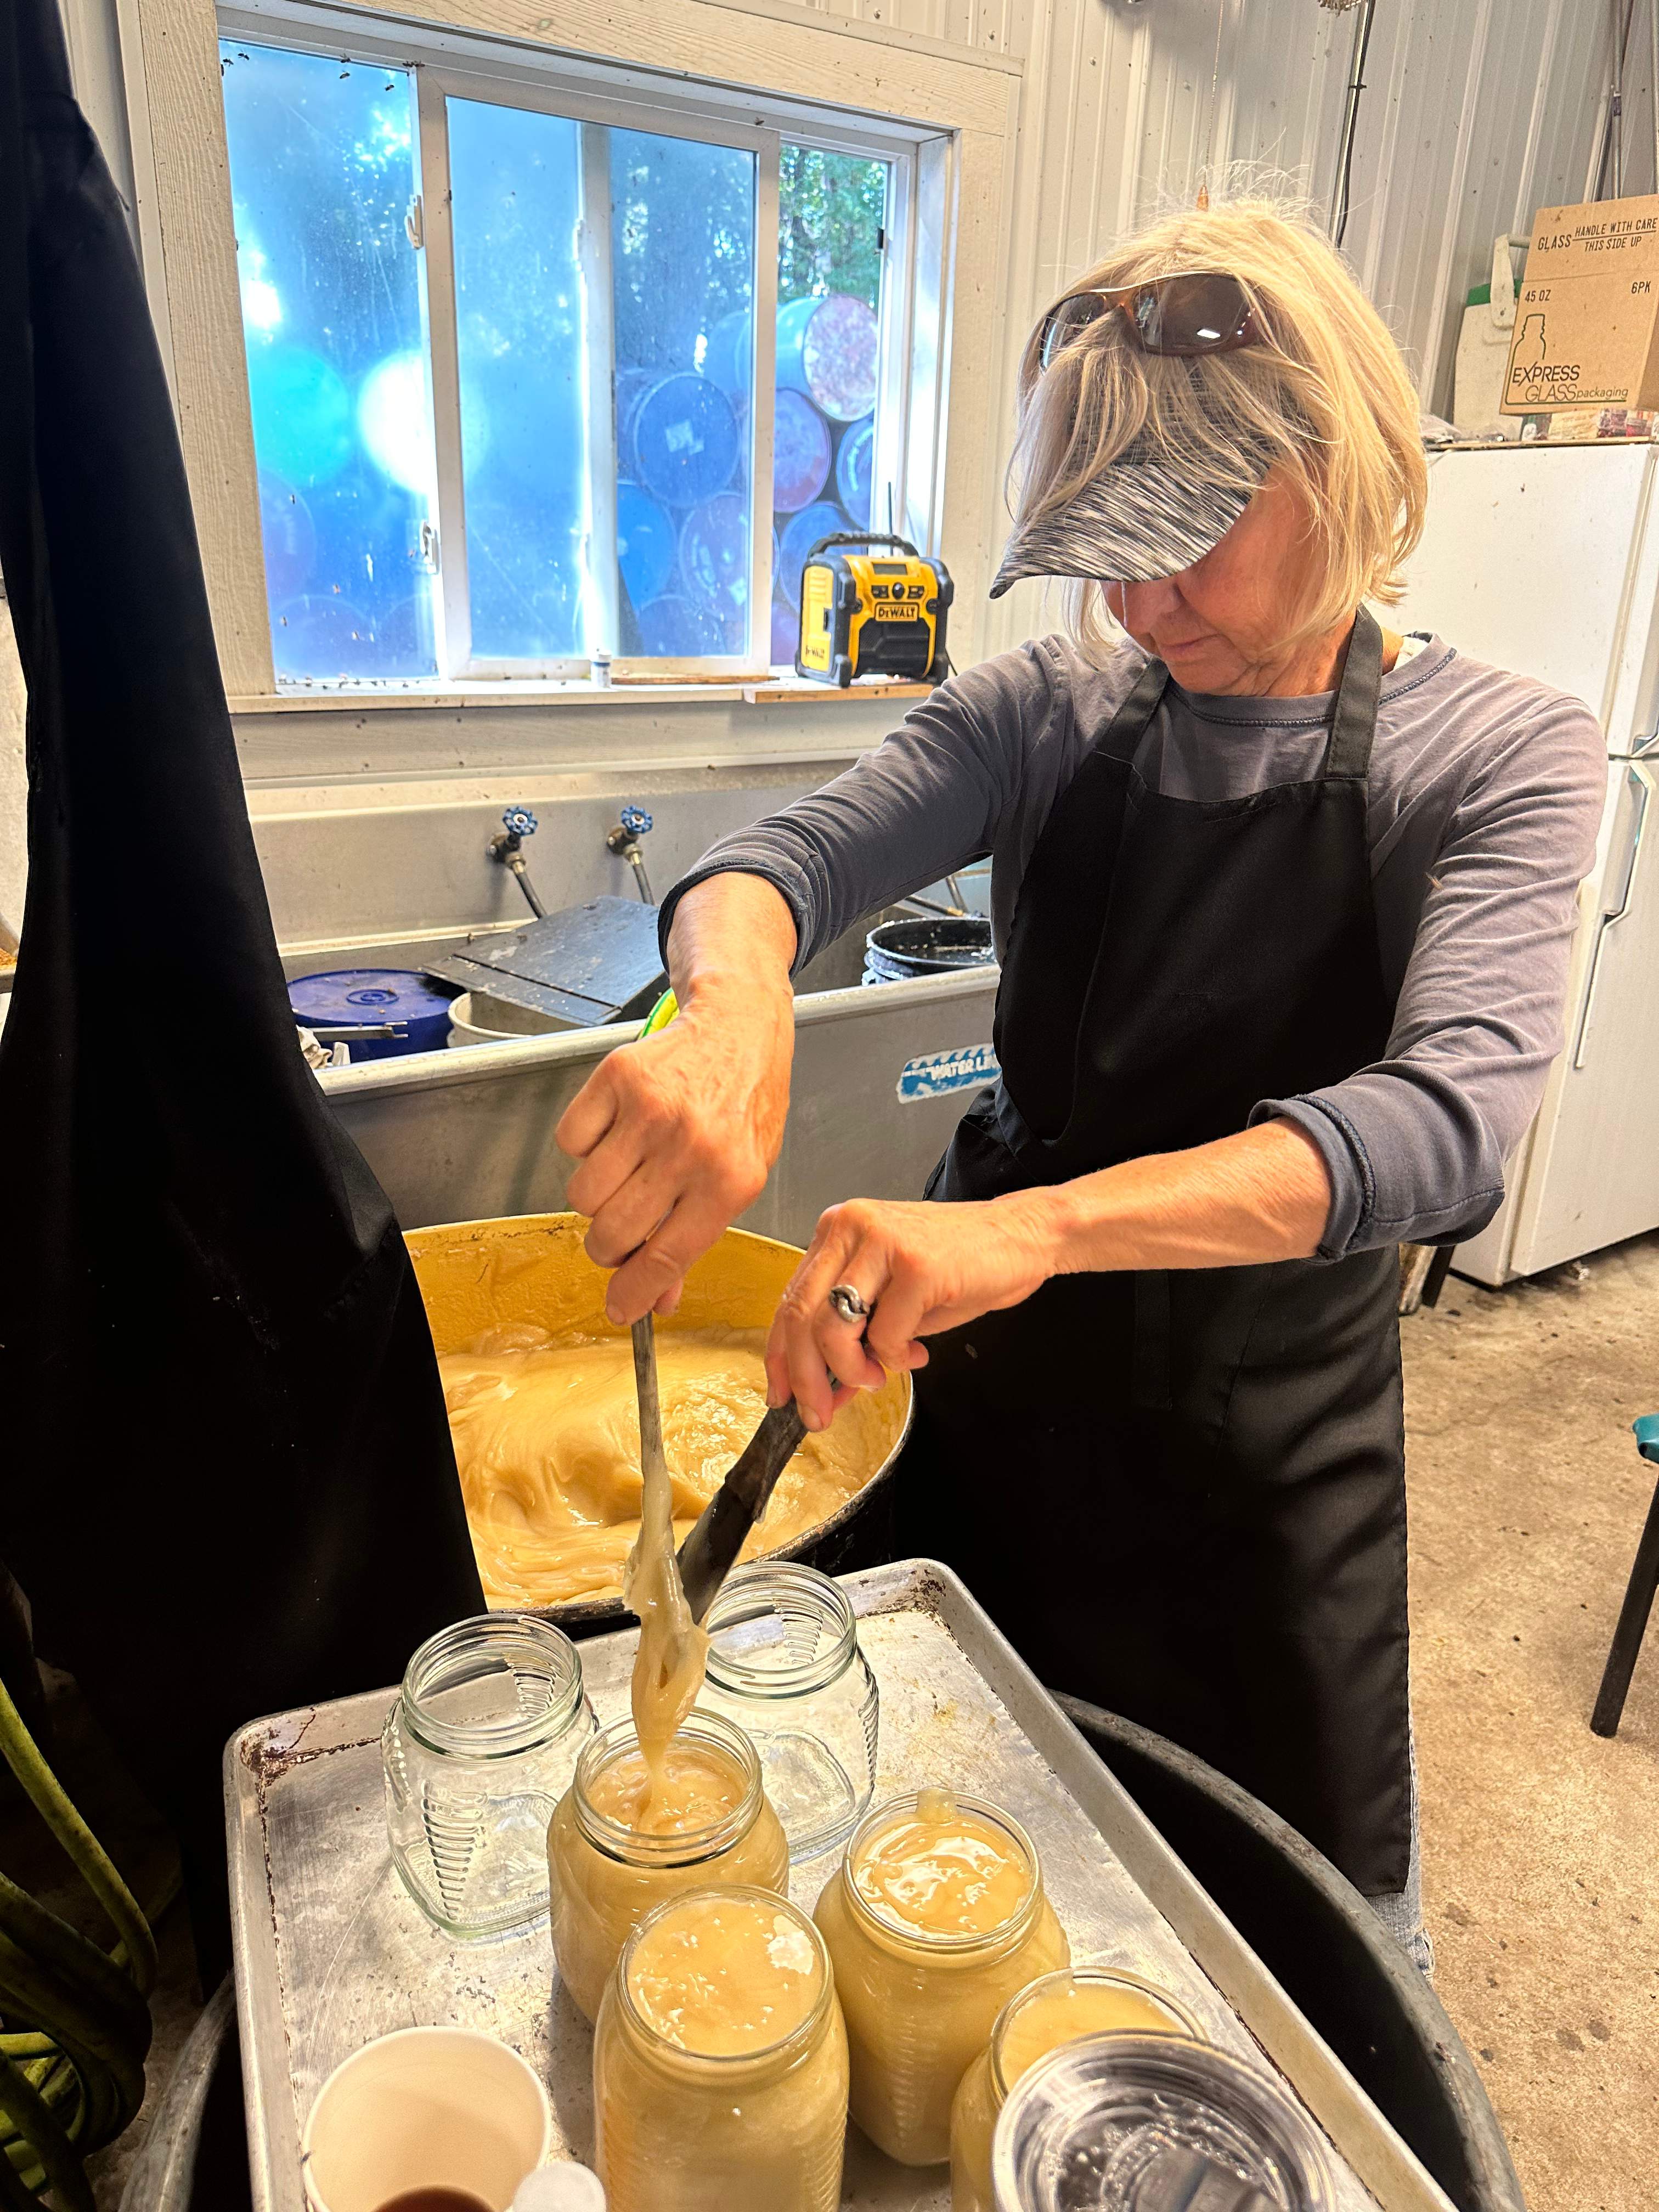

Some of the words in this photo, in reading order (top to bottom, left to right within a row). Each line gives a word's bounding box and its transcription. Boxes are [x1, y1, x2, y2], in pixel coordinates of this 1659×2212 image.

[1575, 223, 1607, 238] HANDLE
[1610, 221, 1633, 233] WITH
[1635, 217, 1658, 230] CARE
[1537, 234, 1572, 251] GLASS
[1584, 240, 1604, 252] THIS
[1606, 237, 1627, 250] SIDE
[1630, 236, 1642, 247] UP
[1525, 291, 1536, 302] 45
[1538, 290, 1551, 302] OZ
[1631, 281, 1651, 294] 6PK
[1512, 361, 1581, 387] EXPRESS
[1525, 383, 1577, 402] GLASS
[1576, 386, 1629, 400] packaging
[930, 1059, 974, 1080] WATER
